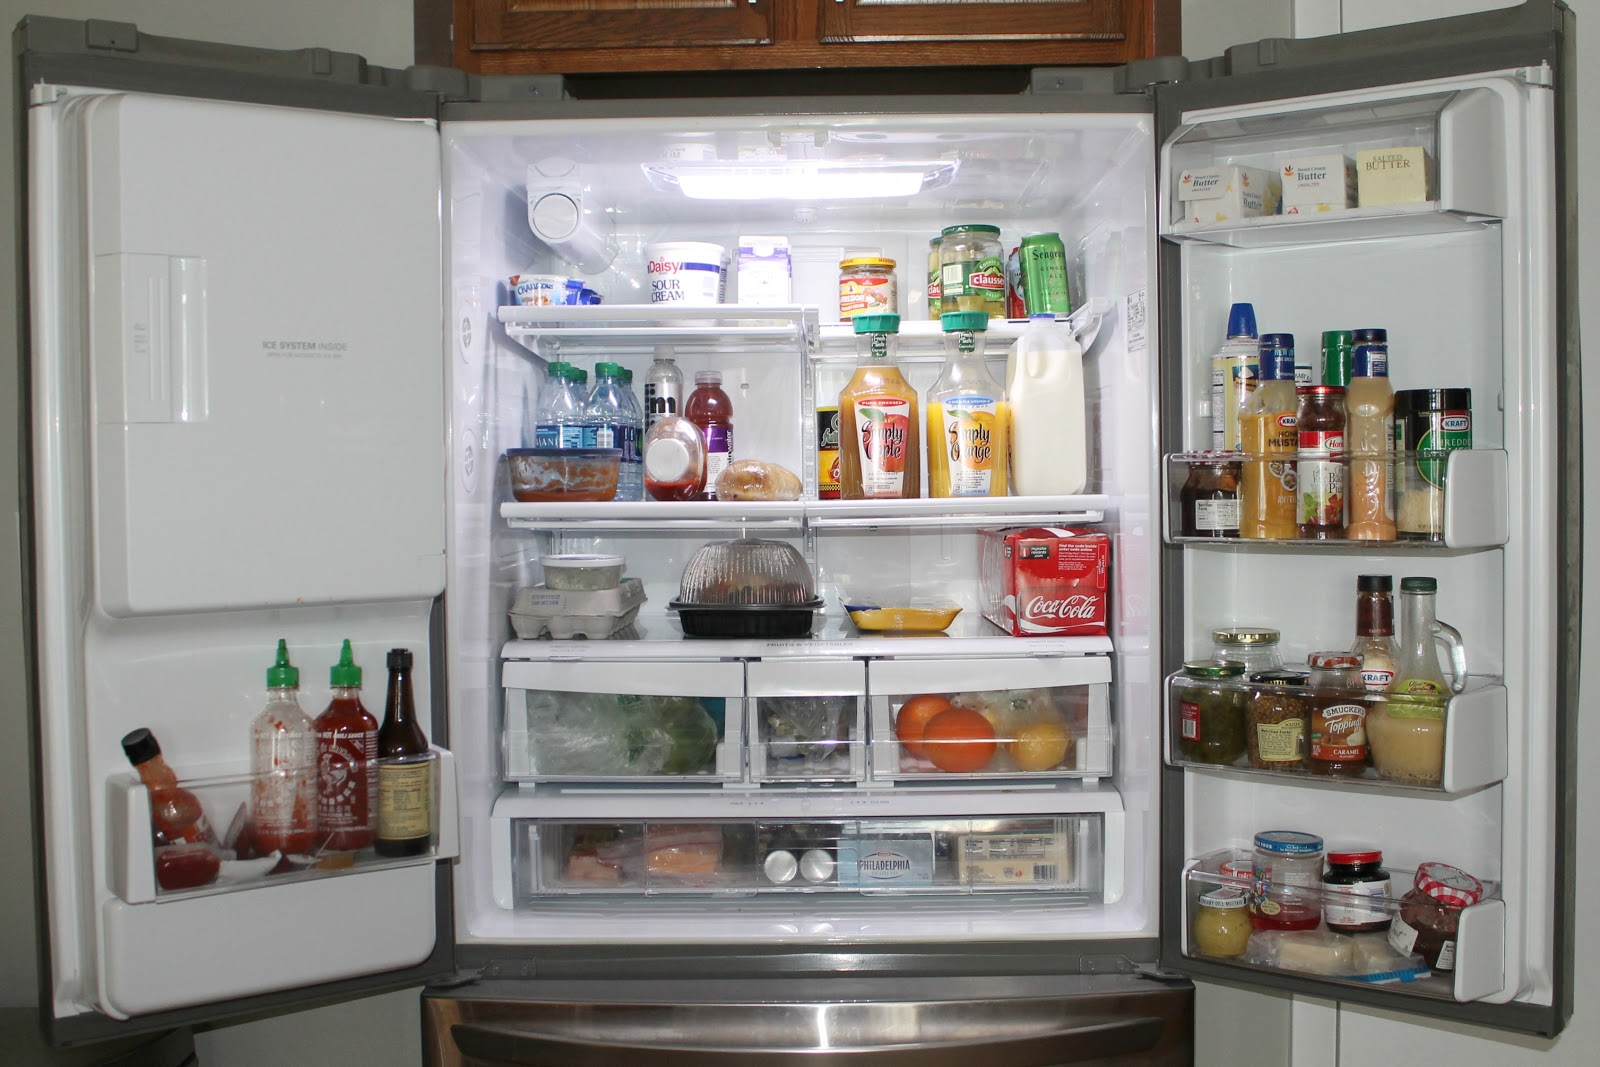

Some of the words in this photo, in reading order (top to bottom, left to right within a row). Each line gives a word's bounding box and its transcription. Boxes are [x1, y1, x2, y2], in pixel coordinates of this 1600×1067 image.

[1366, 159, 1411, 171] BUTTER
[1297, 172, 1326, 181] Butter
[1193, 179, 1219, 187] Butter
[1243, 198, 1262, 210] Butter
[1032, 249, 1065, 260] Seagra
[648, 260, 680, 274] Daisy
[973, 274, 1004, 284] clausse
[651, 280, 680, 291] SOUR
[651, 291, 685, 302] CREAM
[262, 341, 277, 350] ICE
[280, 341, 316, 350] SYSTEM
[318, 342, 348, 351] INSIDE
[1268, 439, 1298, 447] MUSTA
[951, 443, 990, 464] Oange
[1025, 595, 1099, 619] Coca-Cola
[860, 860, 911, 871] PHILADELPHIA
